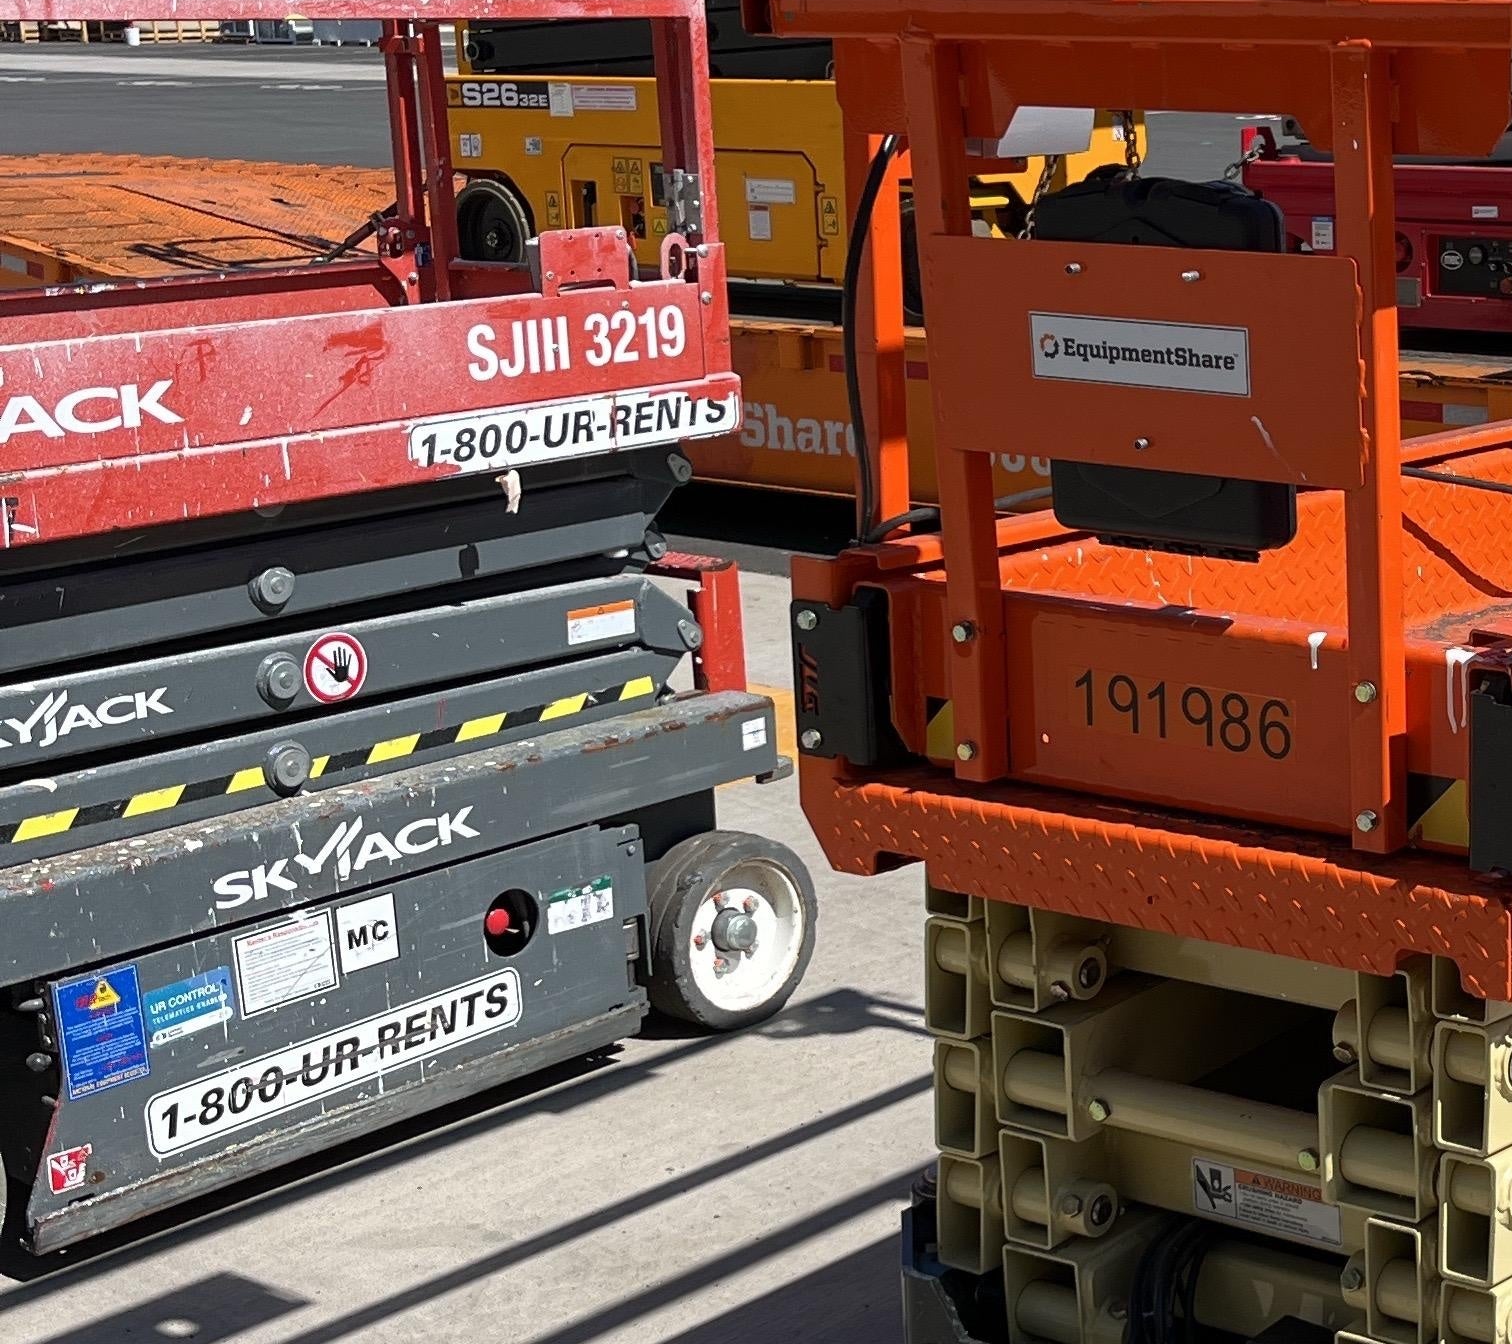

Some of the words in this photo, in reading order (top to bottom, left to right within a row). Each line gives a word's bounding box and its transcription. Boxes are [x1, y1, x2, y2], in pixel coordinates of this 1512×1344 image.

[584, 304, 686, 367] 3219
[1062, 337, 1236, 371] EquipmentShare
[0, 379, 186, 443] ACK
[1075, 669, 1292, 759] 191986
[213, 805, 481, 910] SKYJACK
[168, 983, 220, 1008] CONTROL
[161, 981, 508, 1140] 1-800-UR-RENTS
[1263, 1176, 1322, 1201] WARNING
